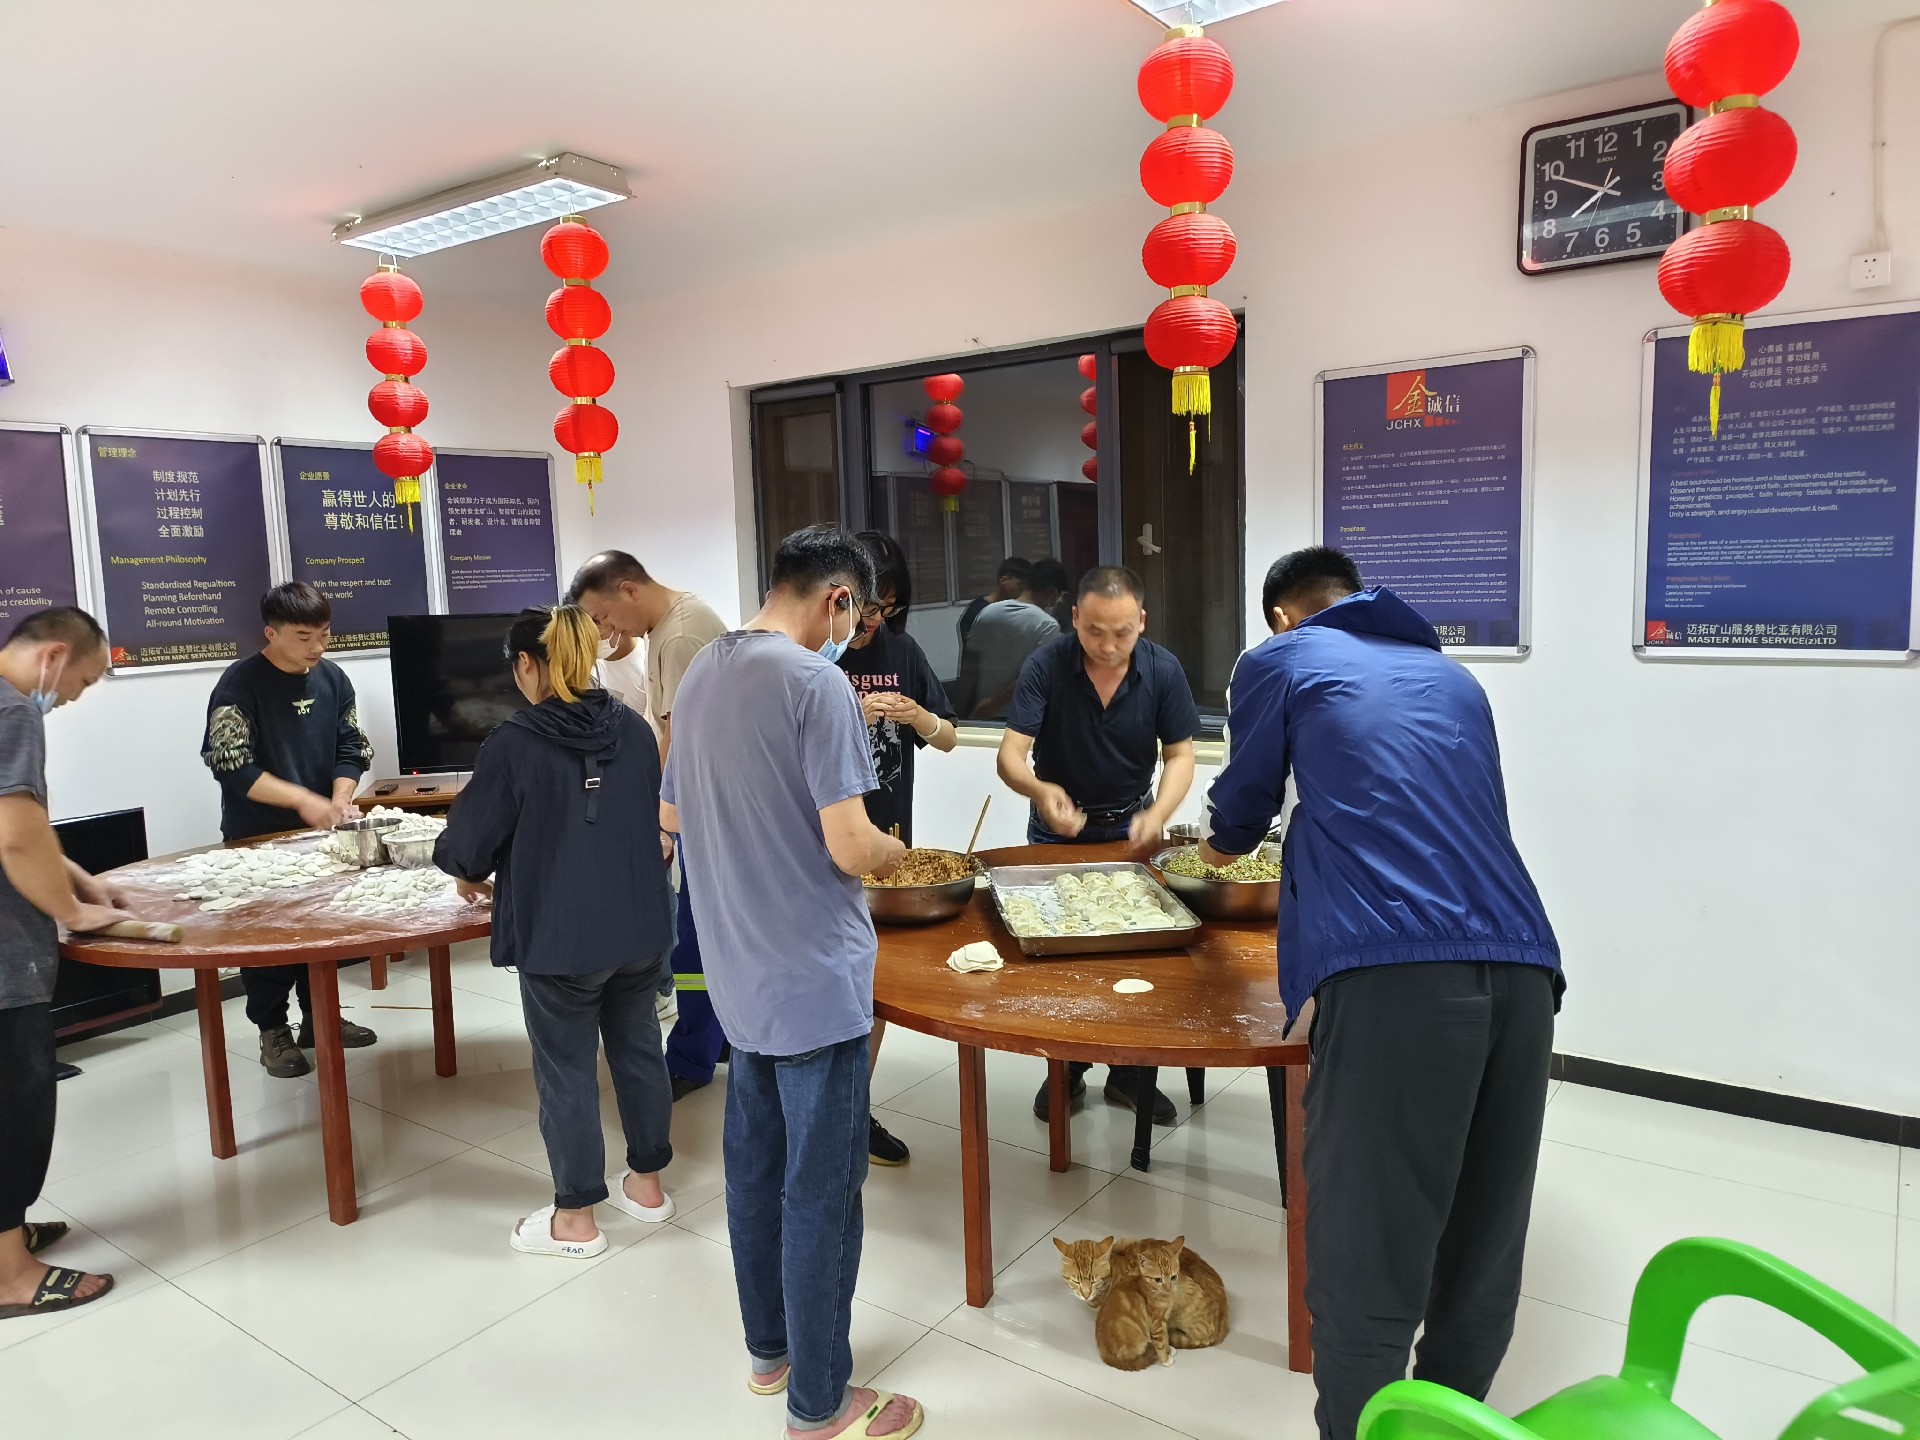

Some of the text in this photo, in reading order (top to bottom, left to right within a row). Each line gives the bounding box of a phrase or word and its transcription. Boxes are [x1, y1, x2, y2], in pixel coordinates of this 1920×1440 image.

[1594, 131, 1618, 154] 12
[1632, 126, 1643, 147] 1
[1566, 137, 1585, 160] 11
[1652, 140, 1668, 162] 2
[1541, 160, 1565, 182] 10
[1651, 170, 1665, 192] 3
[1543, 189, 1558, 210] 9
[1650, 200, 1666, 221] 4
[1542, 218, 1557, 239] 8
[1626, 222, 1641, 243] 5
[1564, 231, 1580, 253] 7
[1594, 227, 1610, 248] 6
[1386, 418, 1422, 431] JCHX
[98, 446, 138, 459] 管理理念
[152, 469, 200, 484] 制度规范
[154, 488, 201, 502] 计划先行
[321, 489, 396, 509] 赢得世人的
[156, 506, 203, 520] 过程控制
[323, 511, 404, 531] 尊敬和信任!
[157, 524, 204, 538] 全面激励
[110, 554, 207, 566] Management Philosophy
[305, 556, 366, 566] Company Prospect
[141, 579, 192, 590] Standardized
[312, 580, 327, 588] Win
[327, 579, 339, 587] the
[340, 579, 364, 588] respect
[364, 578, 377, 586] and
[5, 586, 15, 595] of
[15, 587, 42, 595] cause
[142, 591, 222, 604] Planning Beforehand
[335, 590, 354, 599] world
[9, 597, 53, 607] credibility
[144, 604, 218, 616] Remote Controlling
[145, 617, 225, 628] All-round Motivation
[1686, 623, 1838, 636] 迈拓矿山服务赞比亚有限公司
[1687, 636, 1837, 646] MASTER MINE SERVICE(z)LTD
[141, 654, 171, 663] MASTER
[171, 653, 190, 661] MINE
